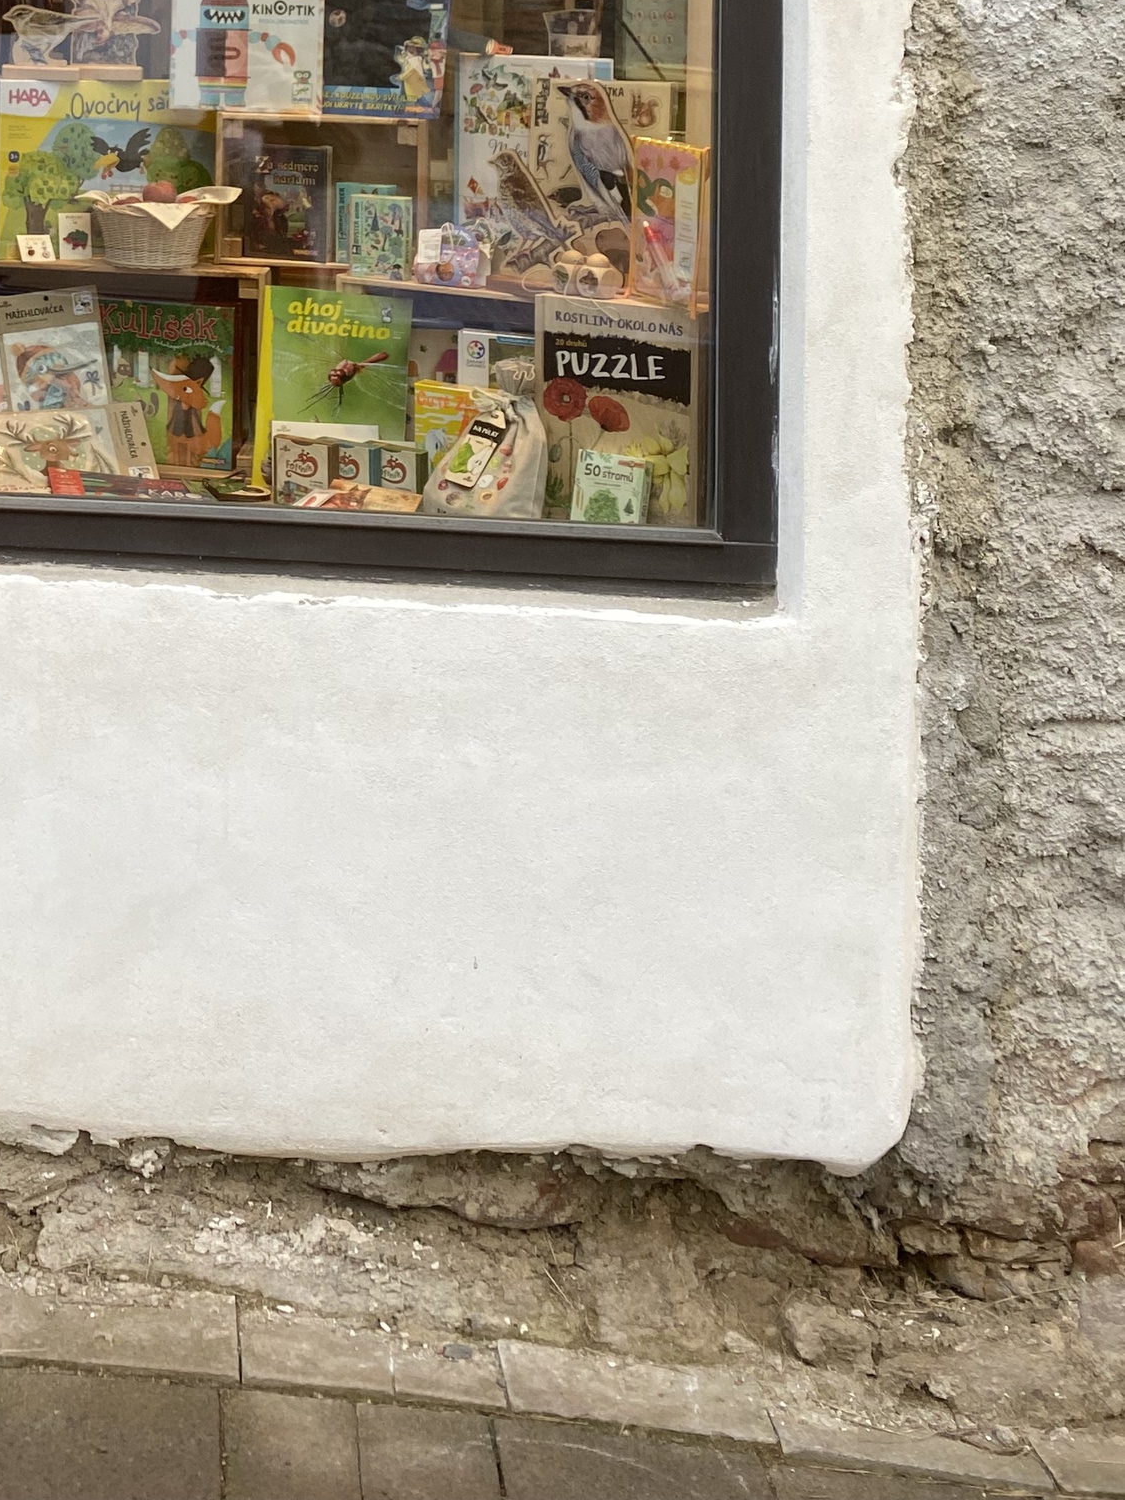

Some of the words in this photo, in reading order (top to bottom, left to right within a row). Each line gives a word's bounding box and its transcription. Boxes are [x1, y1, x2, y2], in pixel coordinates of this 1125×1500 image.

[252, 0, 315, 17] KINOPTIK
[8, 88, 52, 107] HABA
[70, 92, 141, 122] Ovočný
[288, 297, 343, 320] ahoj
[99, 303, 218, 341] Kulišák
[555, 310, 615, 328] ROSTLINY
[617, 319, 657, 333] OKOLO
[659, 321, 684, 337] NÁS
[555, 338, 564, 346] 20
[566, 339, 588, 348] druhů
[555, 350, 666, 381] PUZZLE
[584, 463, 601, 477] 50
